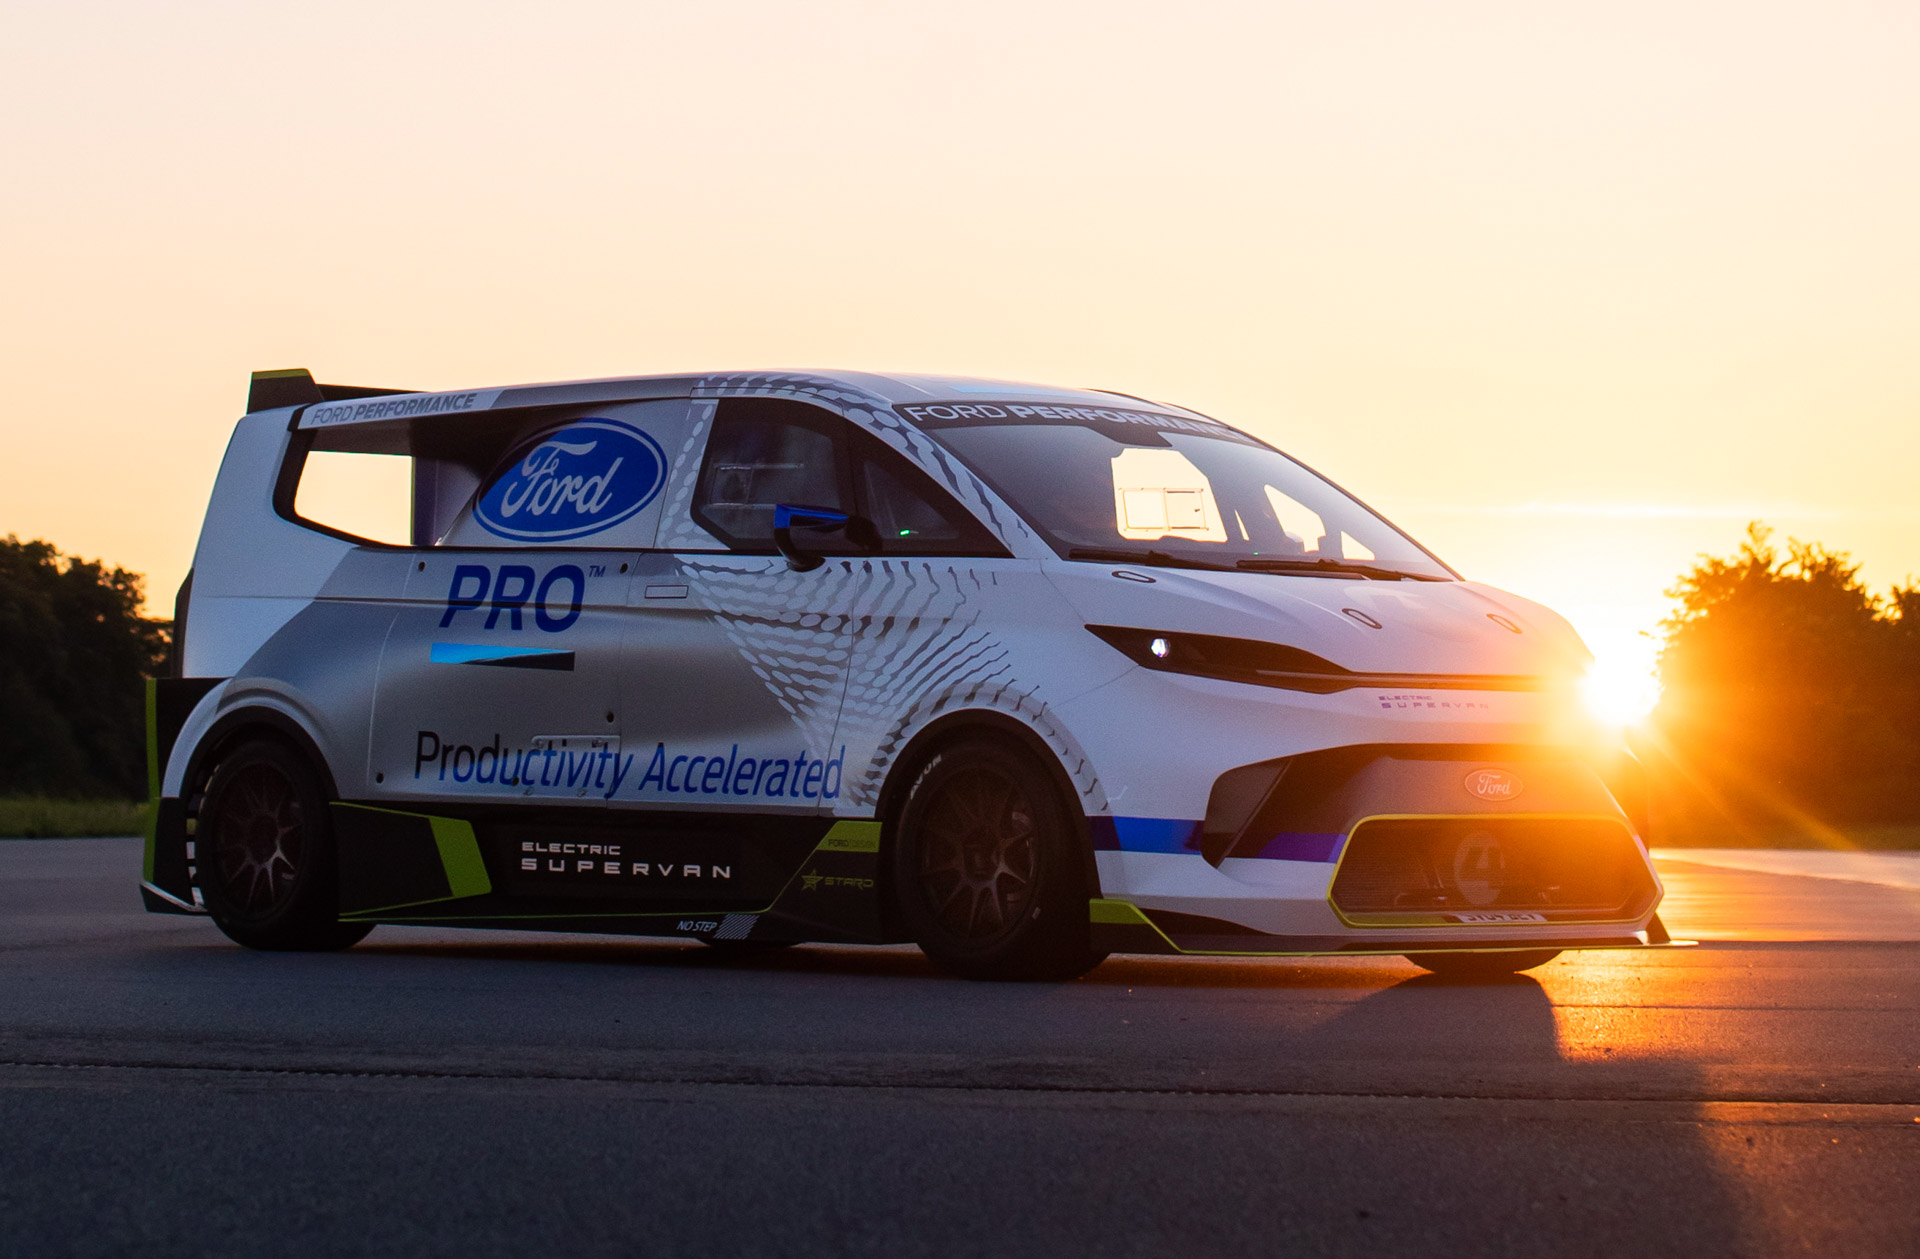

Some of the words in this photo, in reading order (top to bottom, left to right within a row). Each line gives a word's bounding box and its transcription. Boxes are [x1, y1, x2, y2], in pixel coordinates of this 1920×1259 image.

[311, 406, 353, 425] FORD
[353, 393, 477, 421] PERFORMANCE
[903, 405, 1007, 422] FORD
[501, 440, 625, 518] Ford
[439, 564, 585, 633] PRO
[414, 730, 634, 799] Productivity
[638, 742, 846, 799] Accelerated
[1477, 772, 1512, 795] Ford
[521, 841, 621, 856] ELECTRIC
[521, 857, 731, 879] SUPERVAN
[676, 920, 694, 931] NO
[692, 921, 718, 932] STEP
